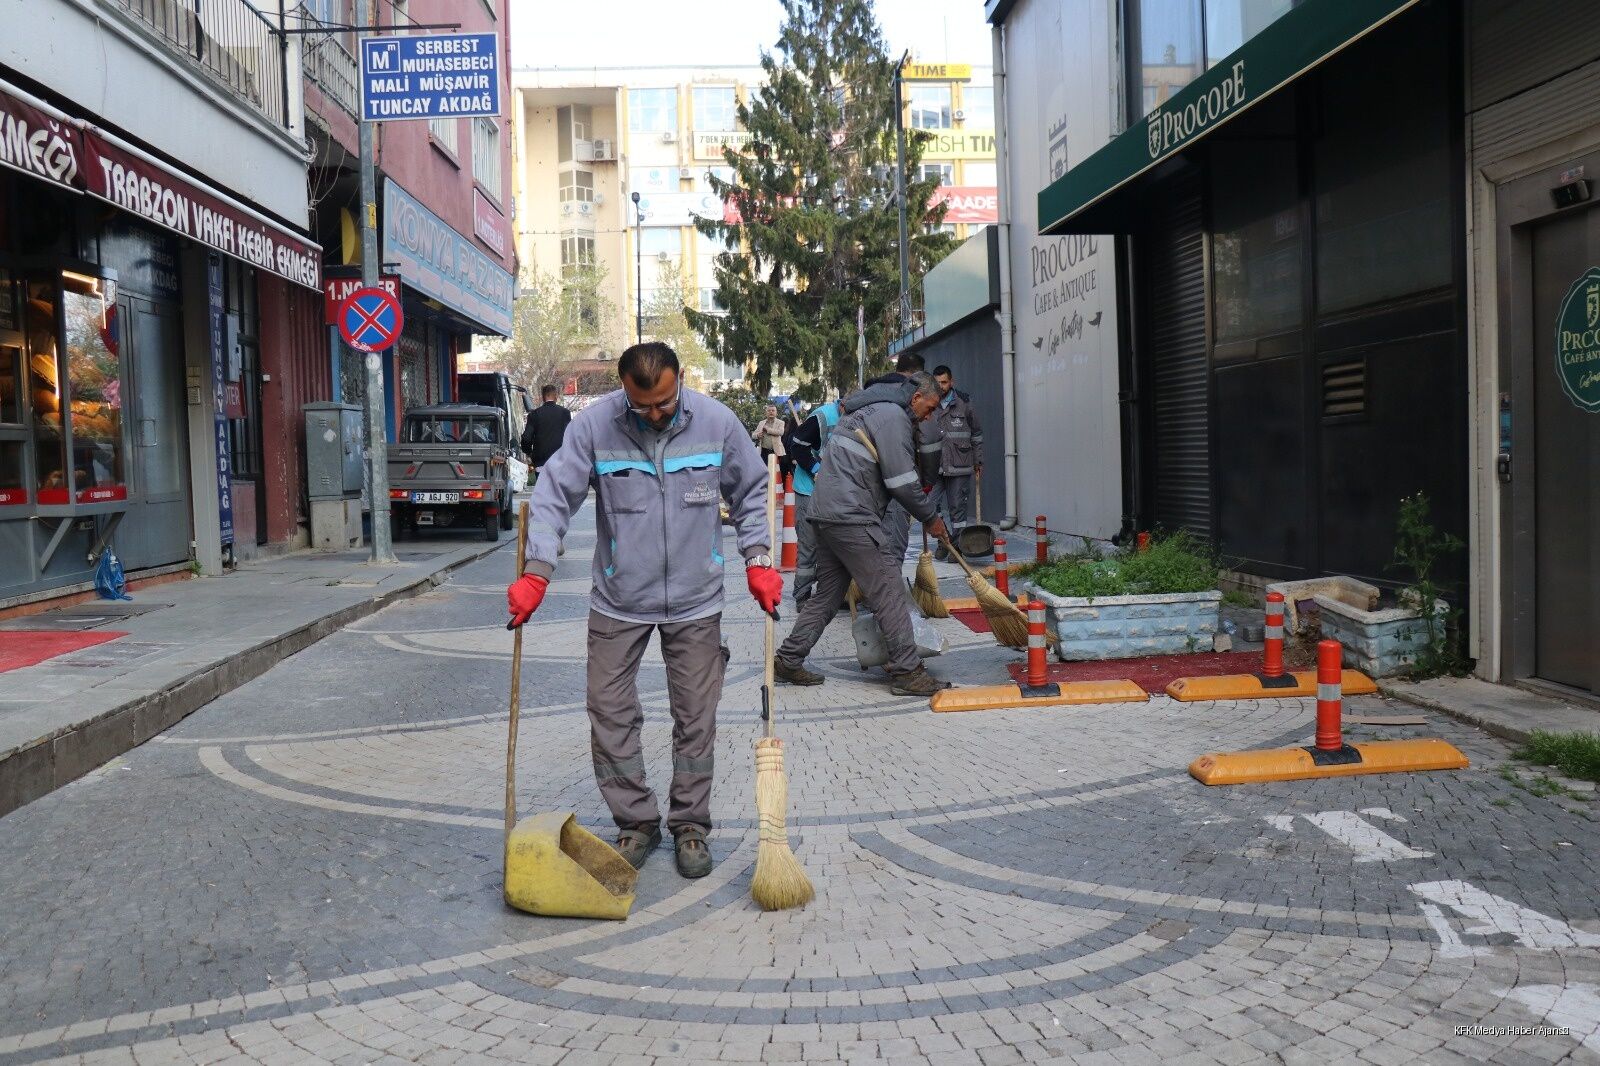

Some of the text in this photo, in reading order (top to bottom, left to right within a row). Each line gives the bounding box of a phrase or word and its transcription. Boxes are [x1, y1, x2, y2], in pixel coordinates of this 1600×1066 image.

[416, 38, 479, 55] SERBEST
[402, 52, 494, 73] MUHASEBECİ
[914, 65, 947, 76] TIME
[371, 72, 489, 94] MALİ MÜŞAVİR
[370, 91, 492, 115] TUNCAY AKDAĞ
[1163, 60, 1246, 150] PROCOPE
[99, 155, 190, 235] TRABZON
[192, 202, 235, 253] VAKFI
[237, 224, 275, 270] KEBİR
[276, 244, 319, 289] EKMEĞİ
[390, 189, 456, 281] KONYA
[1060, 268, 1097, 307] ANTIQUE
[213, 312, 224, 413] TUNCAY
[416, 493, 458, 501] 32 AGJ 920
